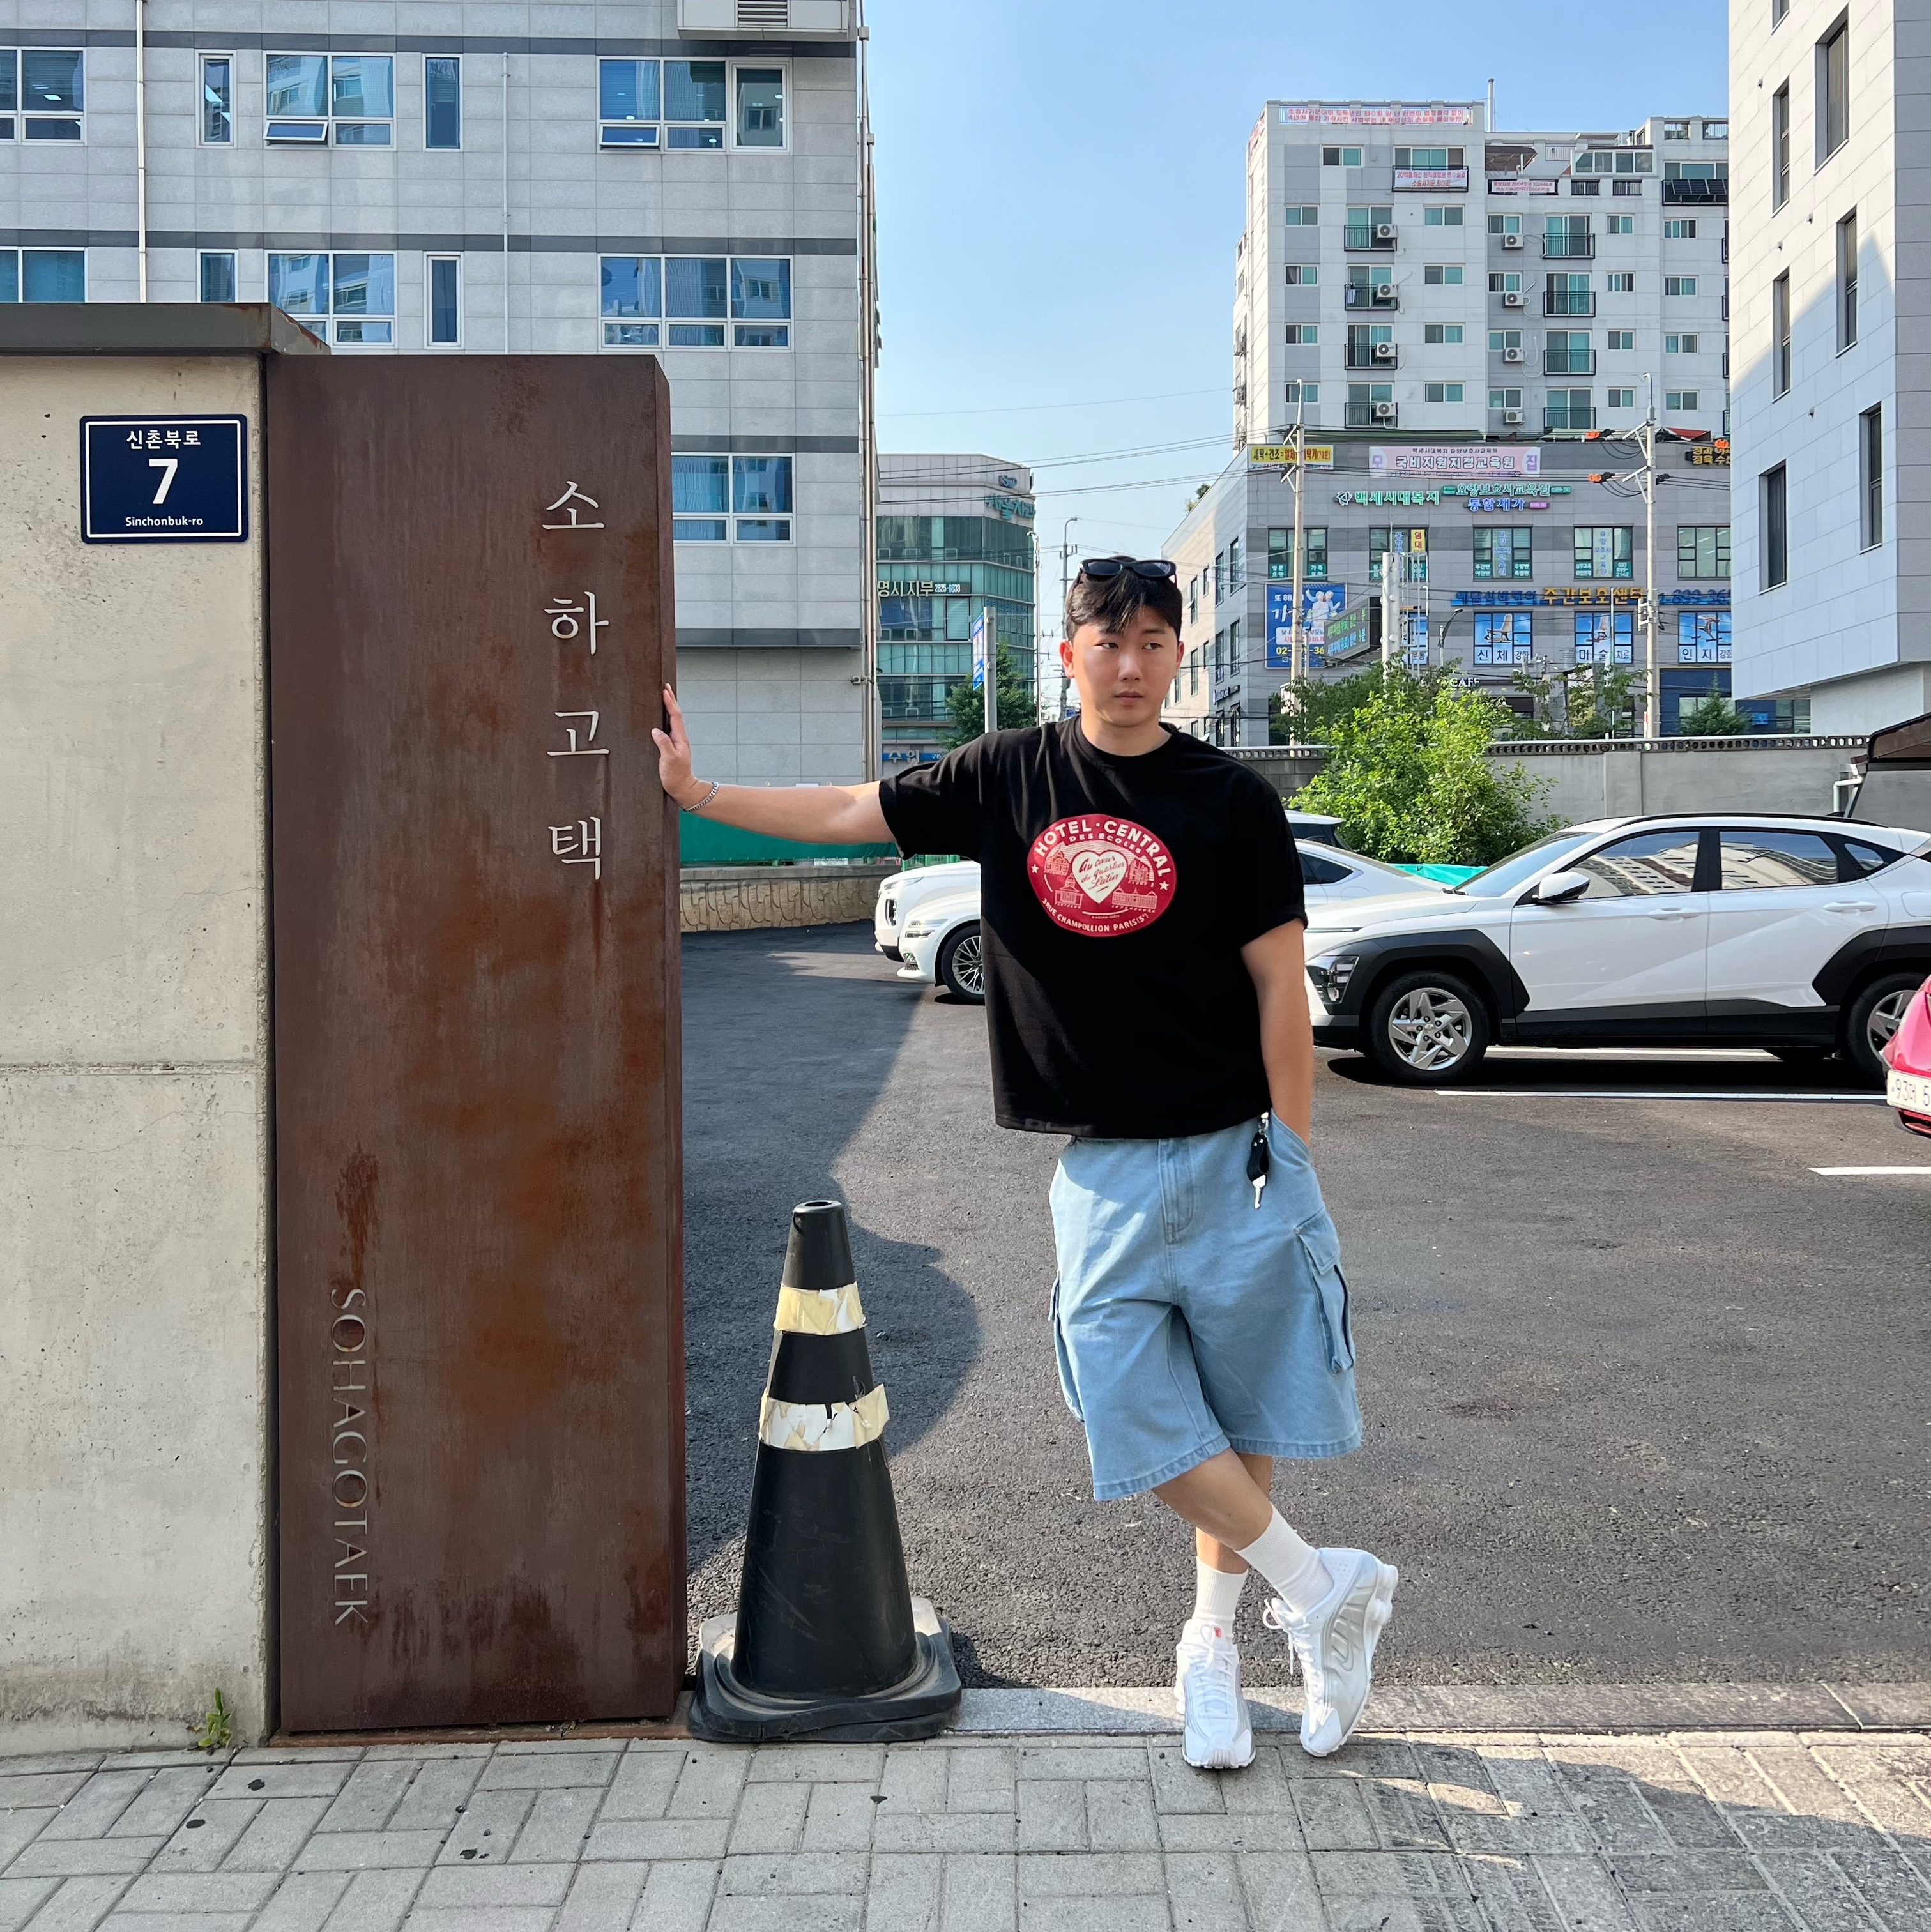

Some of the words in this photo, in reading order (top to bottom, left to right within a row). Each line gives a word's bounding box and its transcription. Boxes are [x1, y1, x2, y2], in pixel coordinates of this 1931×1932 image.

[126, 430, 201, 450] 신촌북로
[1396, 455, 1515, 469] 국비지원지정교육원
[149, 458, 178, 505] 7
[1456, 483, 1551, 496] 요양보호사교육원
[1354, 491, 1440, 506] 백세시대복지
[1469, 498, 1525, 511] 통합재가
[125, 516, 204, 527] Sinchonbuk-ro
[1414, 532, 1423, 549] 임대
[935, 584, 961, 593] 2625-6633
[542, 480, 609, 881] 소하고택
[1034, 819, 1092, 857] HOTEL
[1104, 820, 1172, 877] CENTRAL
[1069, 833, 1094, 842] DES
[1098, 832, 1142, 855] ÉCOLES
[1079, 858, 1093, 873] Au
[1088, 872, 1118, 890] Latin
[1057, 913, 1110, 932] CHAMPOLLION
[331, 1288, 369, 1626] SOHAGOTAEK
